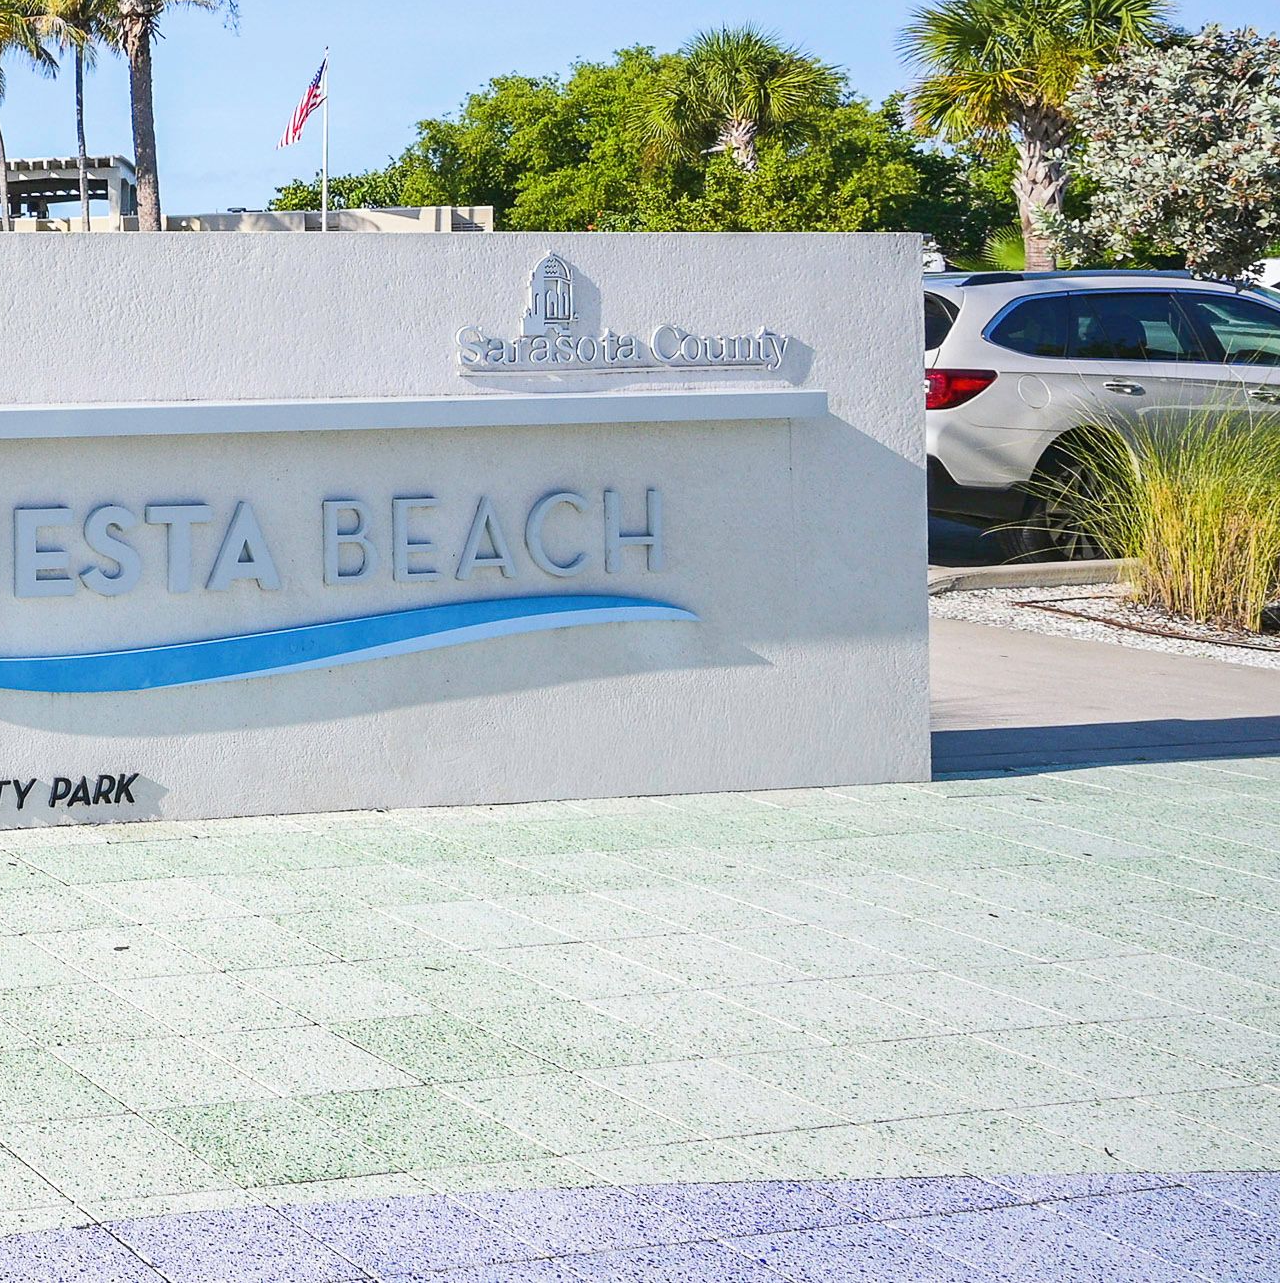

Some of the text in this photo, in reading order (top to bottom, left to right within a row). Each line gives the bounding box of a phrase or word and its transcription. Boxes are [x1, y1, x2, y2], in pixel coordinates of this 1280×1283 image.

[455, 324, 792, 372] Sarasota County
[322, 488, 663, 588] BEACH
[48, 772, 140, 808] PARK
